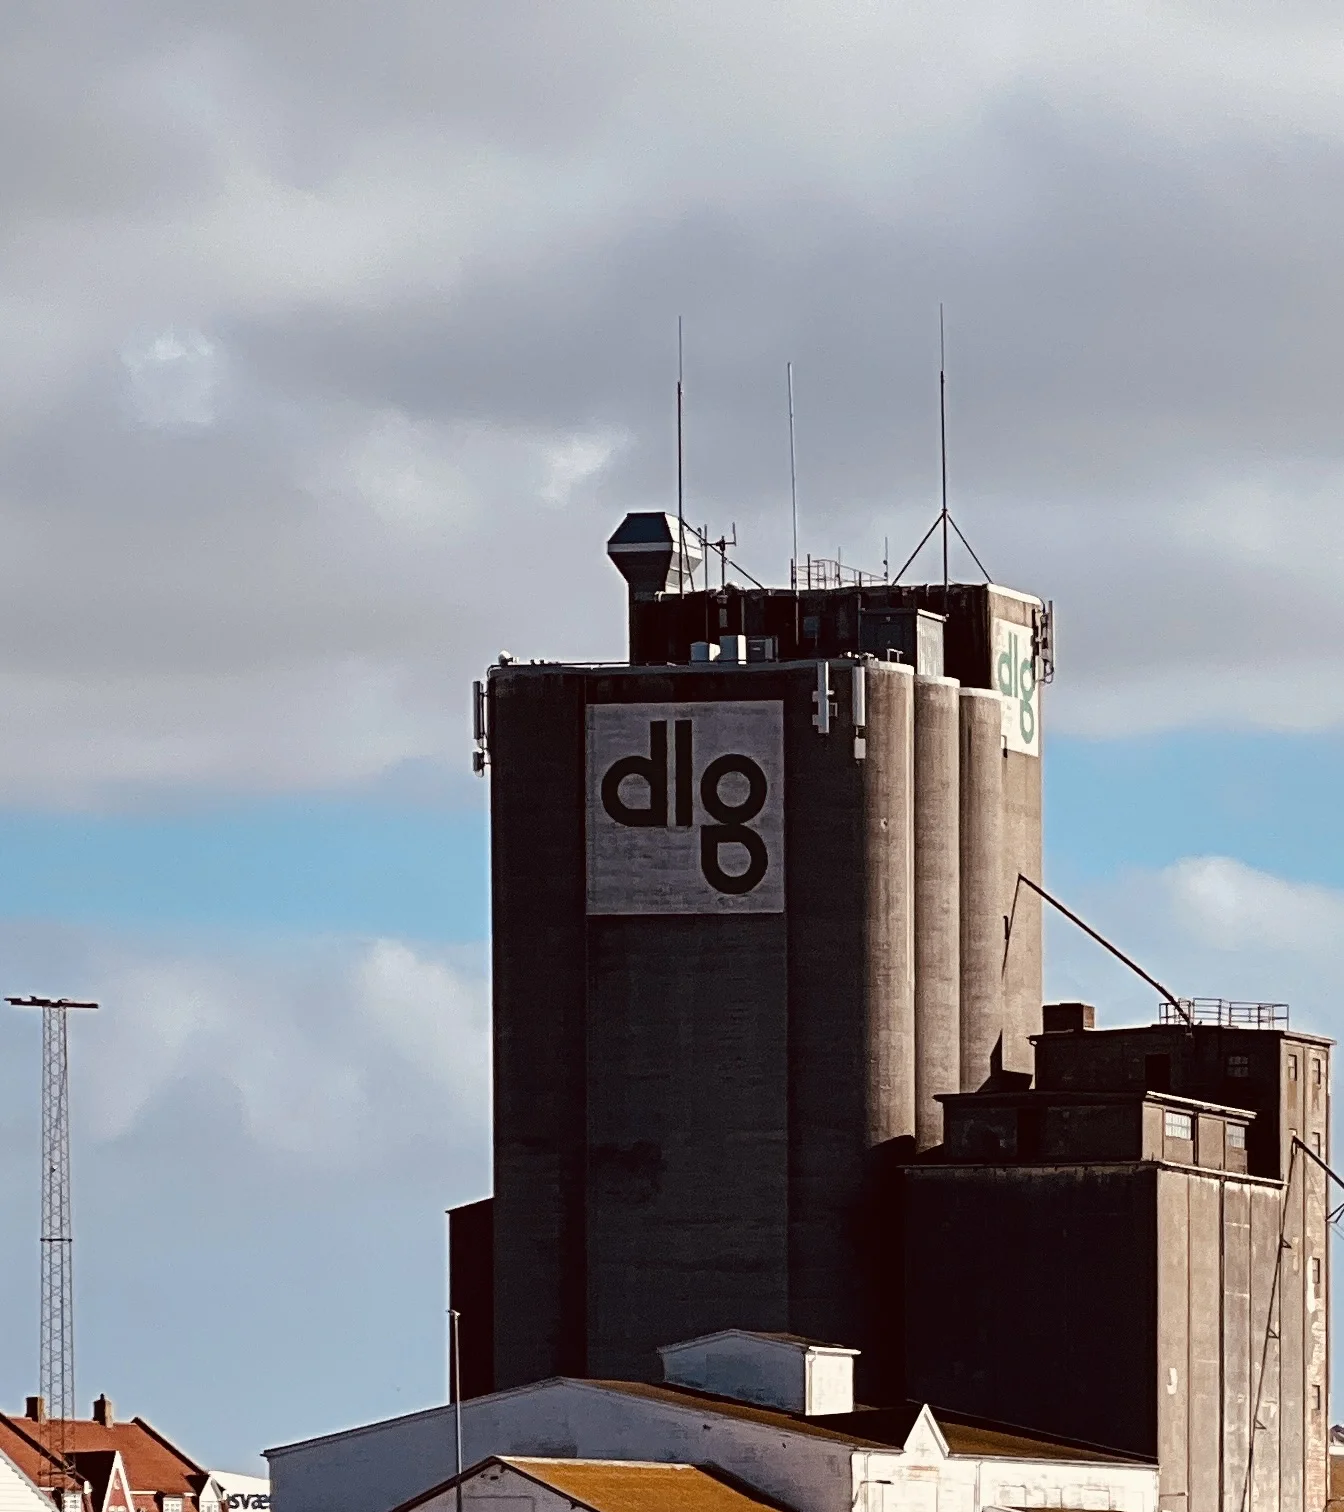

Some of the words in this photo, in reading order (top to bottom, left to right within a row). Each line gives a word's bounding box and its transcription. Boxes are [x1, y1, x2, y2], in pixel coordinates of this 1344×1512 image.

[998, 631, 1035, 744] dlg
[601, 719, 768, 895] dlg
[227, 1493, 270, 1510] svæ
